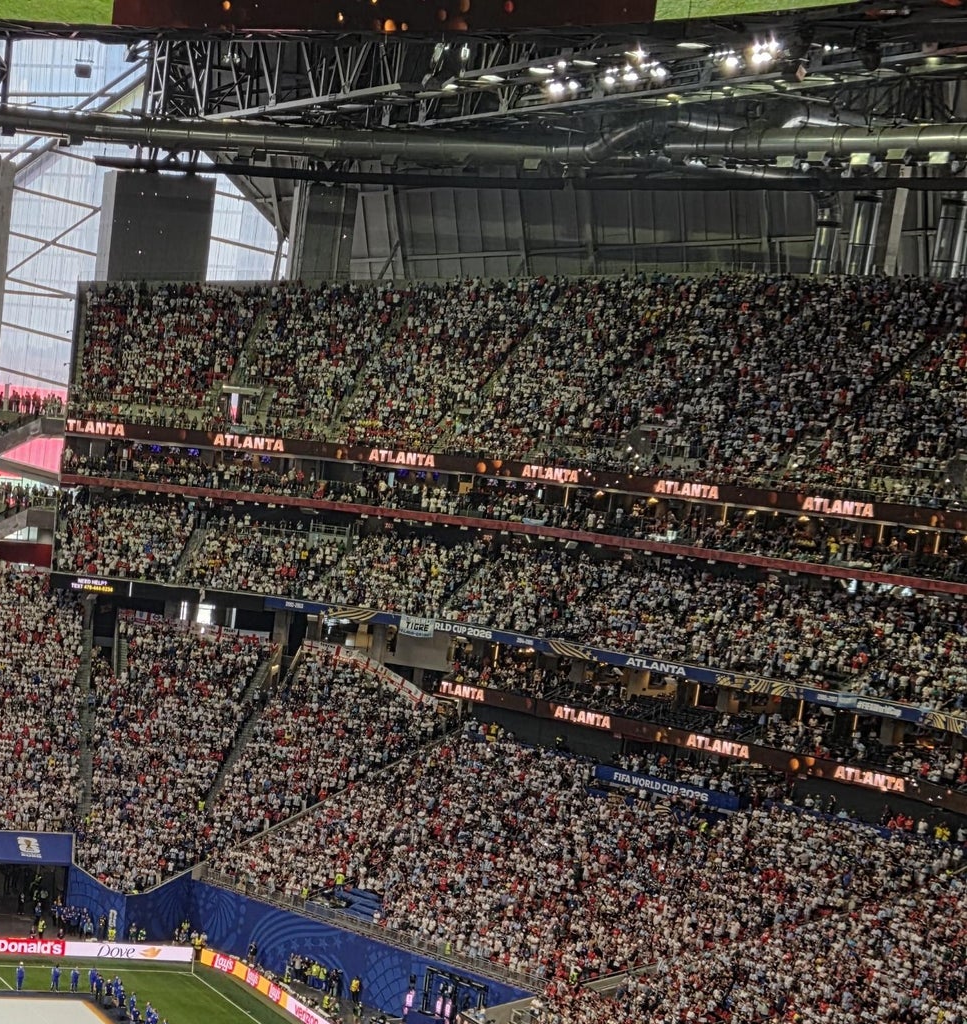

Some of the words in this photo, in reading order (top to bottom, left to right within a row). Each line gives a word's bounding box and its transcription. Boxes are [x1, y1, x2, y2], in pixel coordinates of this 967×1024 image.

[65, 419, 125, 436] TLANTA
[213, 433, 284, 451] ATLANTA
[369, 449, 435, 467] ATLANTA
[521, 464, 578, 483] ATLANTA
[655, 480, 719, 500] ATLANTA
[802, 496, 874, 518] ATLANTA
[453, 624, 467, 634] CUP
[467, 627, 492, 639] 2026
[626, 657, 686, 676] ATLANTA
[554, 704, 611, 729] ATLANTA
[686, 733, 750, 759] ATLANTA
[613, 771, 631, 784] FIFA
[632, 775, 661, 791] WORLD
[662, 784, 678, 794] CUP
[833, 765, 905, 793] ATLANTA
[97, 943, 136, 958] Dove
